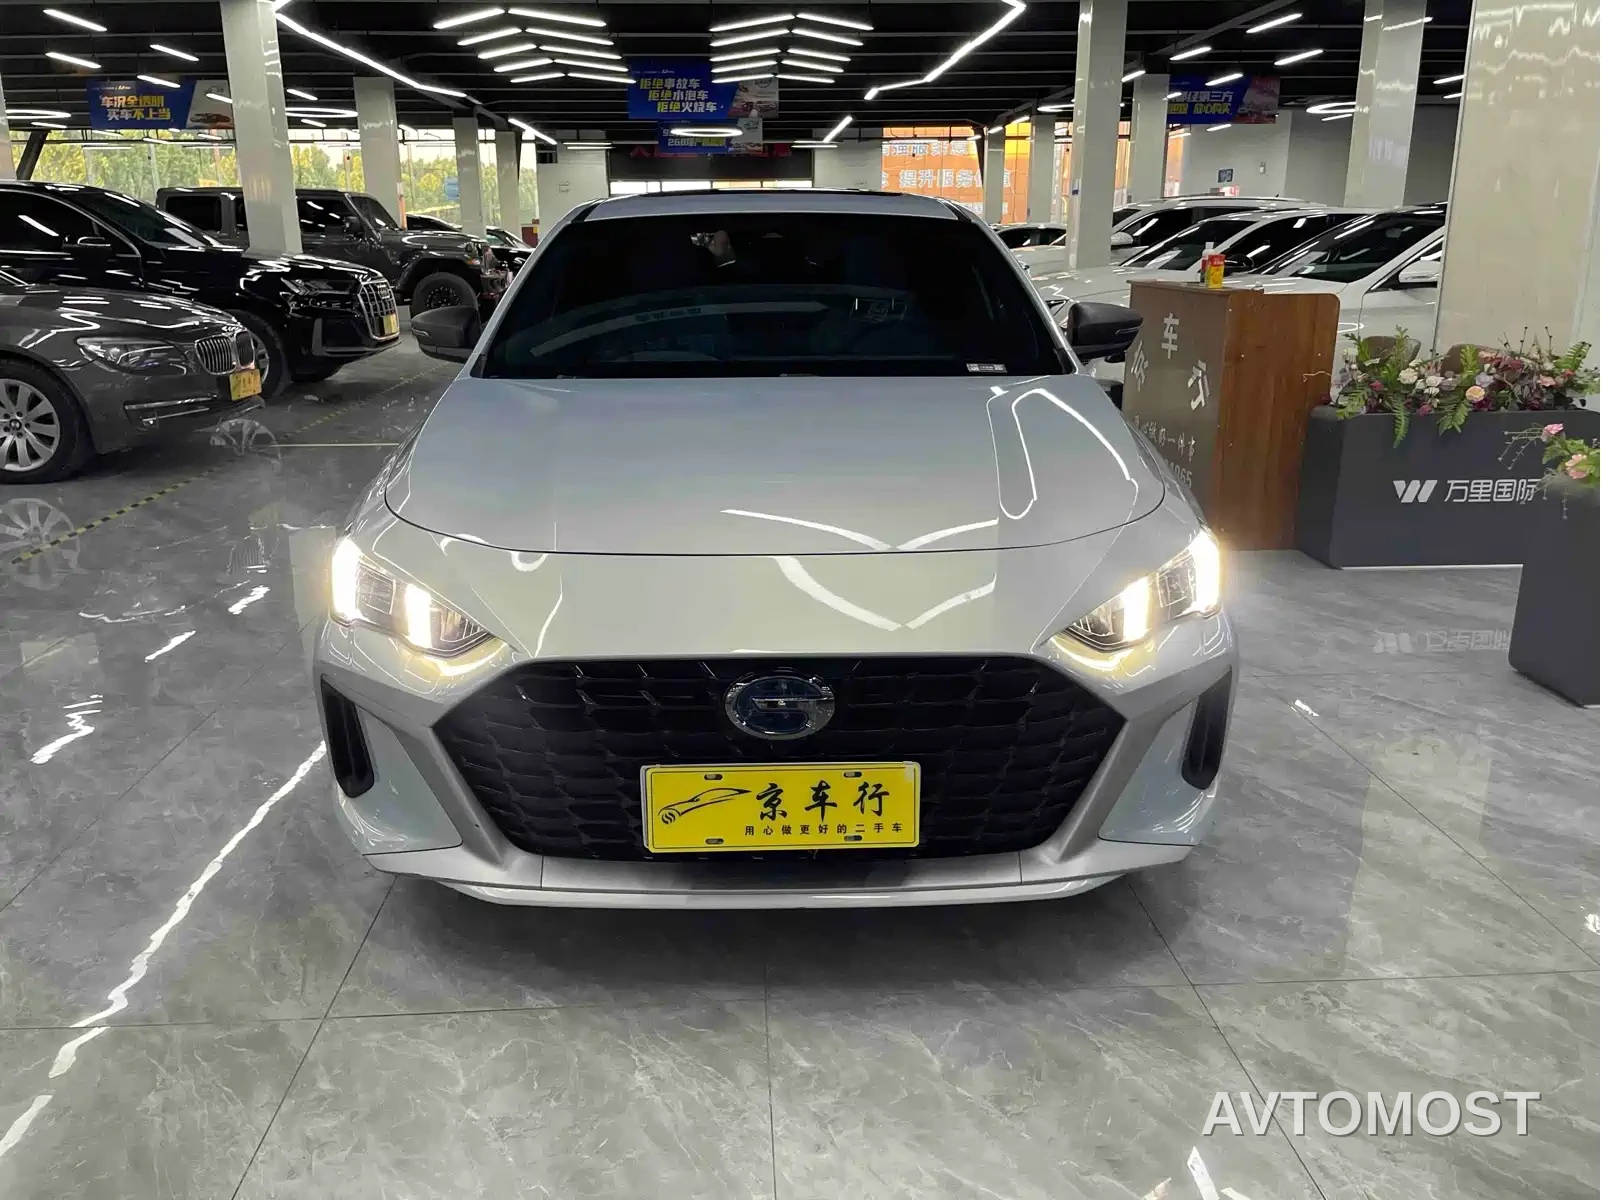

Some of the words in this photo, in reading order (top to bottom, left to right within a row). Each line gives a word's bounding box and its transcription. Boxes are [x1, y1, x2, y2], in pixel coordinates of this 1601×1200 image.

[640, 78, 701, 90] 拒绝事故车
[101, 95, 165, 108] 车况全透明
[648, 90, 709, 102] 拒绝水泡车
[657, 101, 718, 113] 拒绝火烧车
[106, 107, 171, 121] 买车不上当
[1444, 478, 1542, 503] 万里国际
[756, 780, 890, 822] 京车行
[744, 822, 903, 836] 用心做更好的二手车
